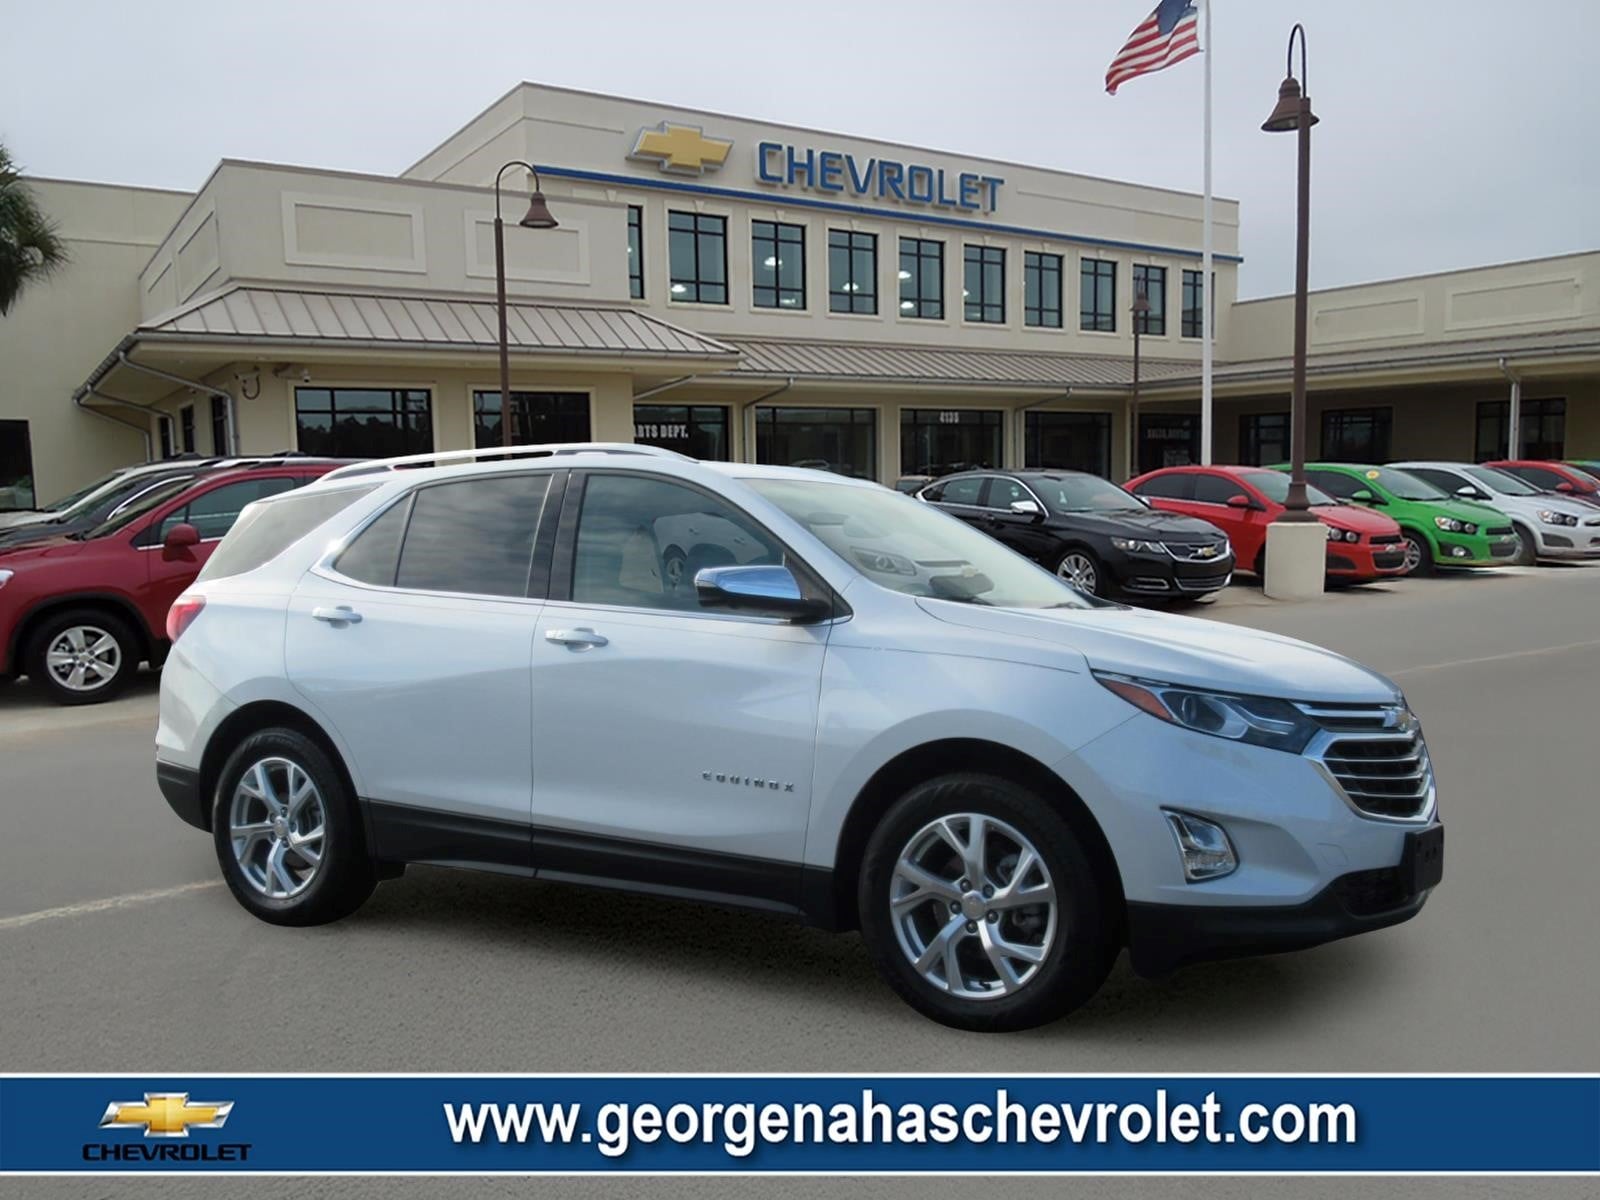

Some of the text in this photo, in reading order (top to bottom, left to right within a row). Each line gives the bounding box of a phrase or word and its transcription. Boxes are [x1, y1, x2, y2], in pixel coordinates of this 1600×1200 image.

[757, 141, 1005, 214] CHEVROLET
[660, 424, 689, 438] DEPT.
[702, 770, 794, 793] EQUINOX
